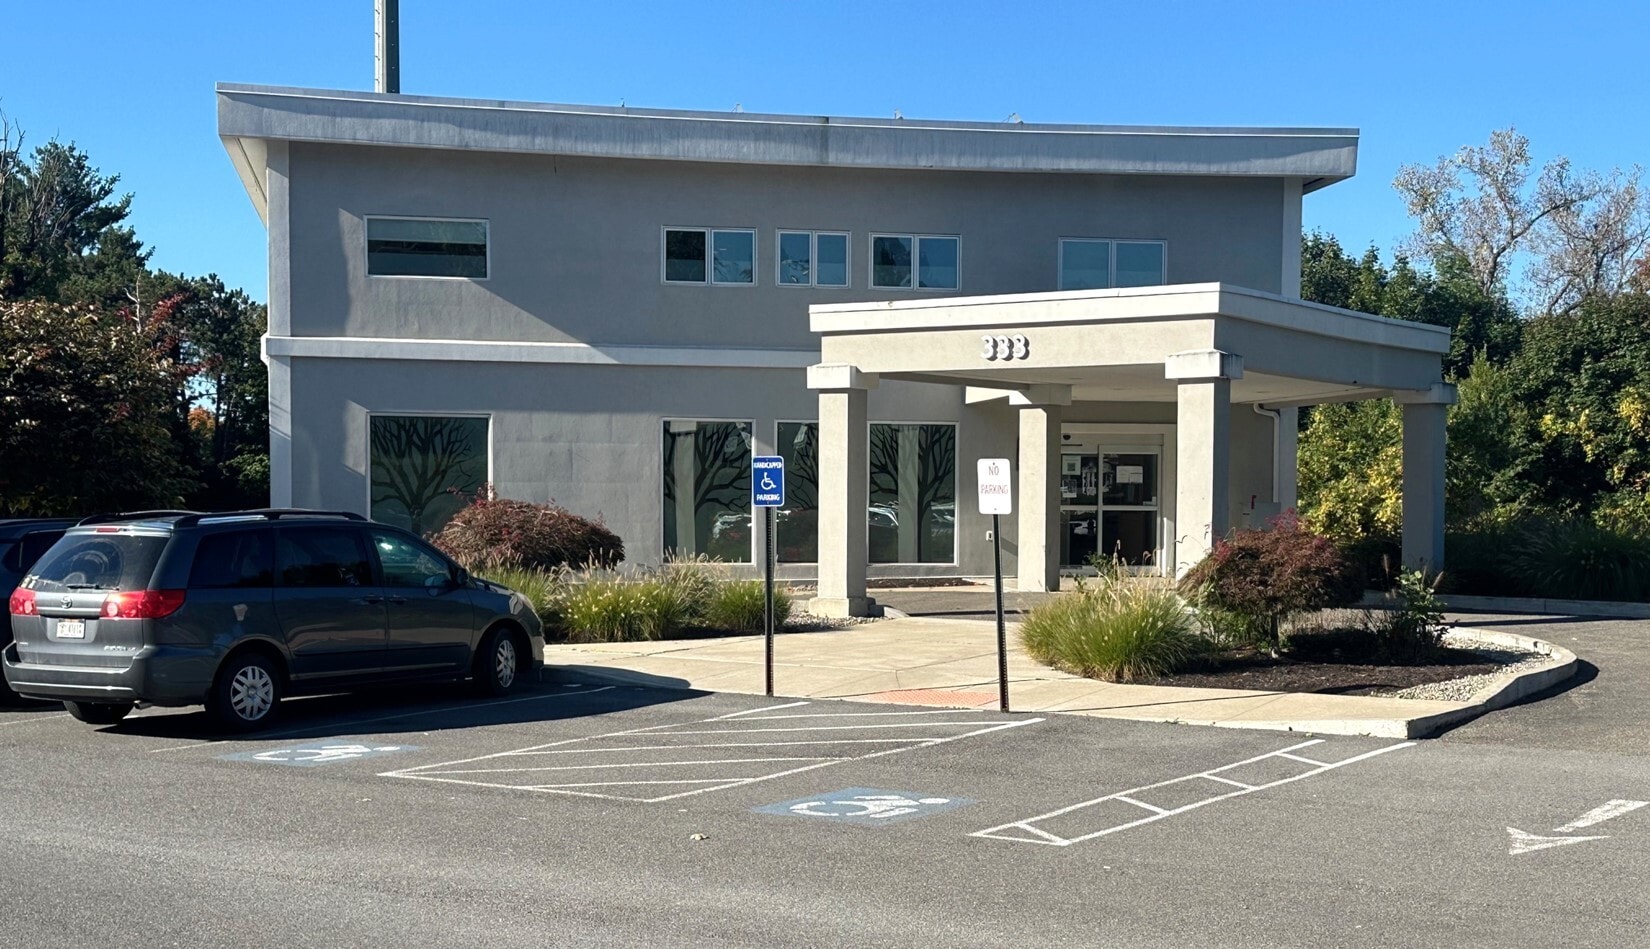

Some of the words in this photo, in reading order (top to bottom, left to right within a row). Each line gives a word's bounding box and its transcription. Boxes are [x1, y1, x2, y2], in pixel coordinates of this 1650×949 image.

[980, 333, 1028, 360] 333
[988, 465, 1000, 476] NO
[980, 484, 1009, 495] PARKING
[756, 493, 780, 501] PARKING
